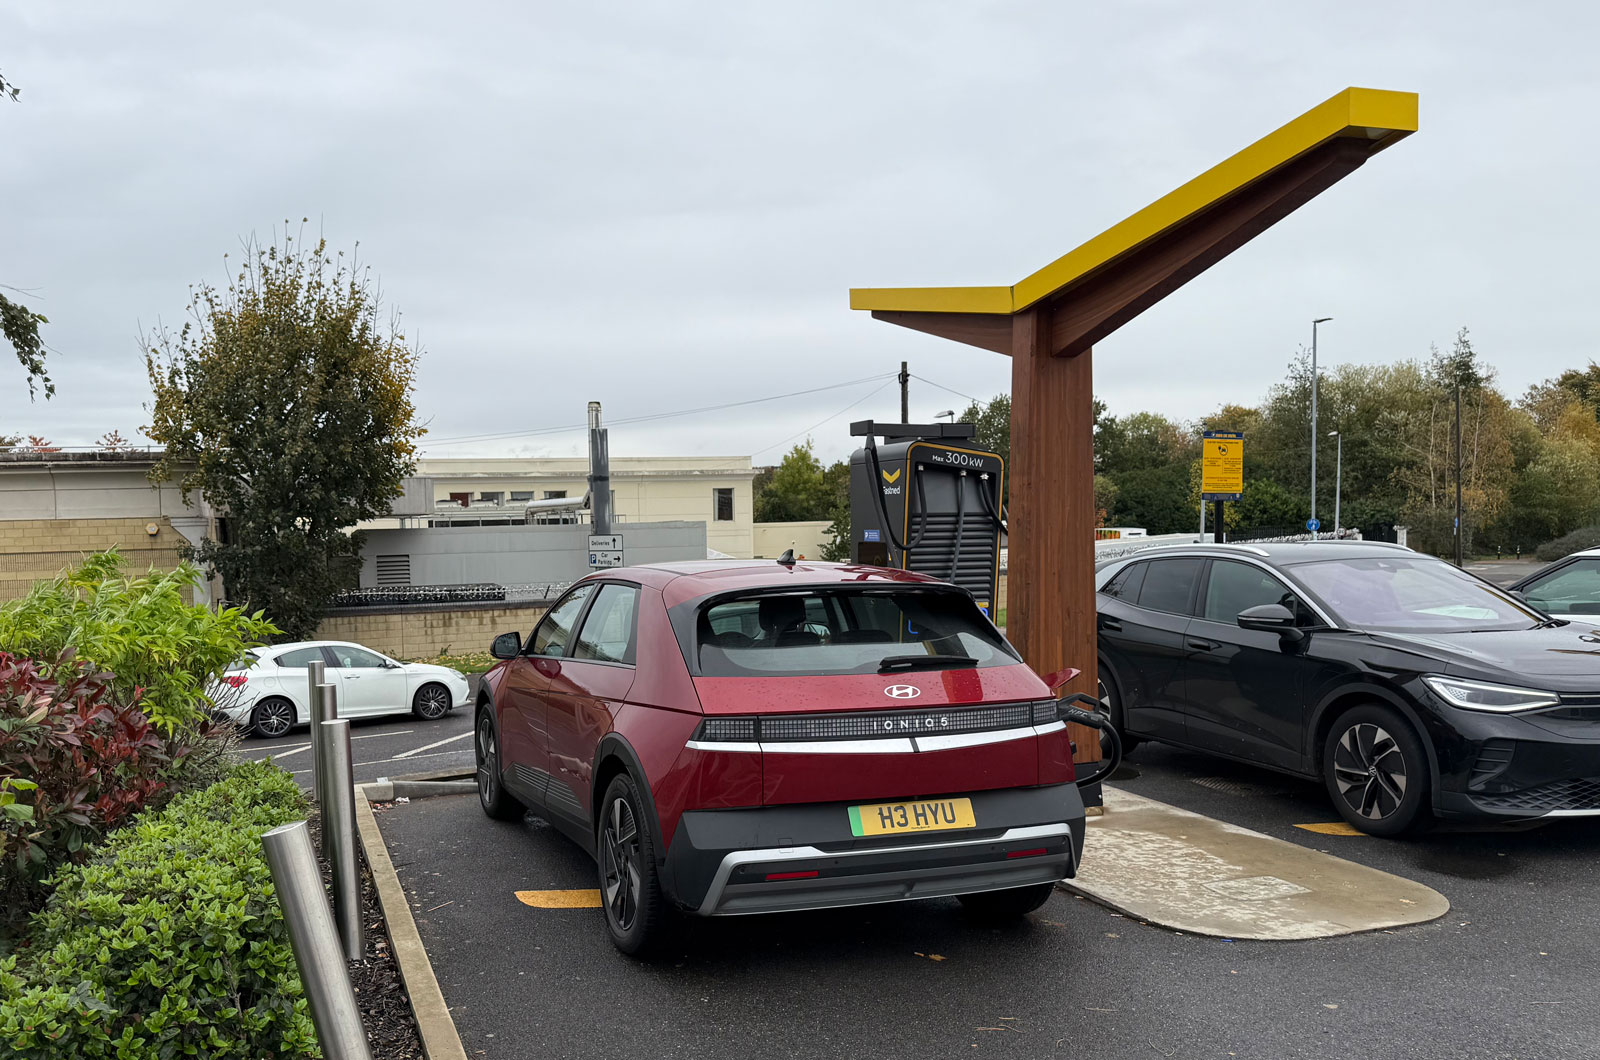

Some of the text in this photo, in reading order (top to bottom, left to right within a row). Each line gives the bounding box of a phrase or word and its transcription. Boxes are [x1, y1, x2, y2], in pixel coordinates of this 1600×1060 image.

[932, 452, 984, 467] Max 300 kW
[873, 717, 948, 730] IONIQ 5
[878, 802, 956, 829] H3 HYU
